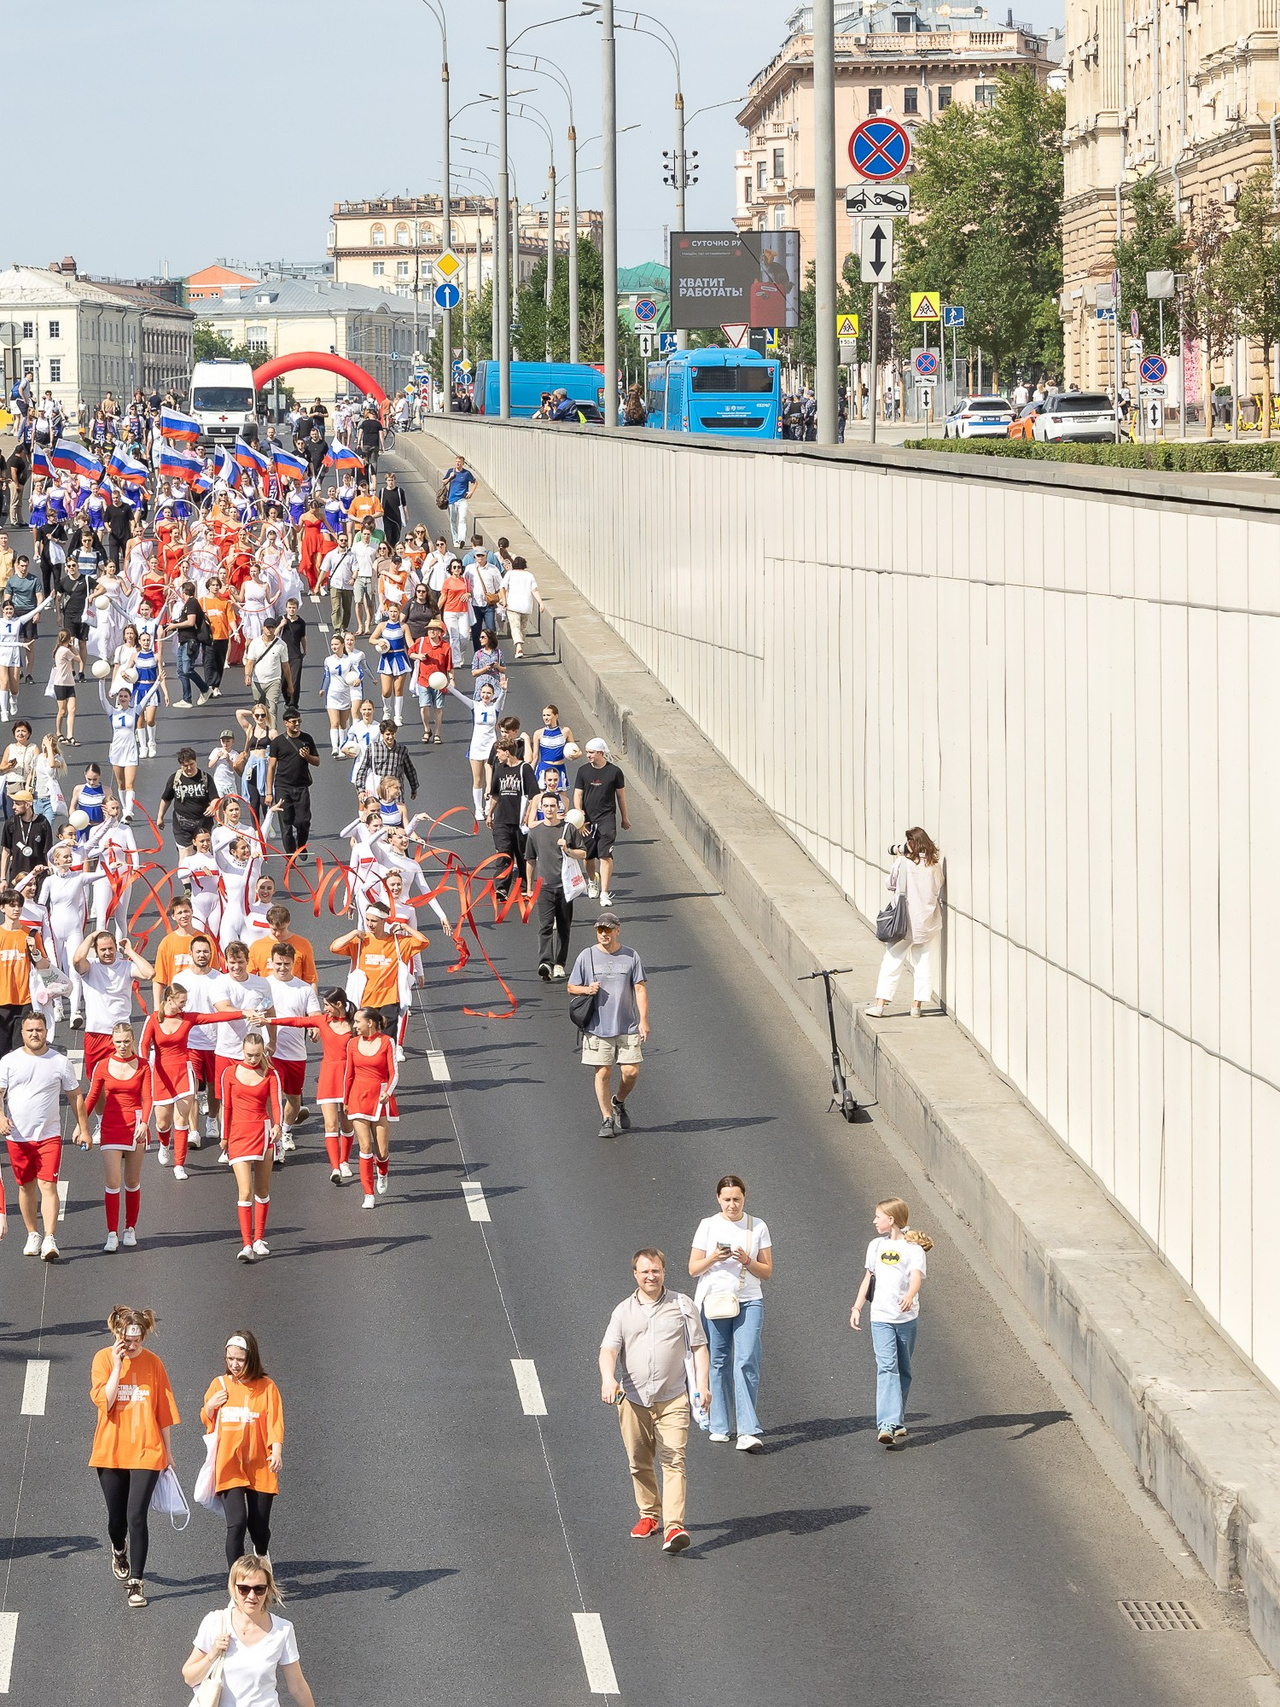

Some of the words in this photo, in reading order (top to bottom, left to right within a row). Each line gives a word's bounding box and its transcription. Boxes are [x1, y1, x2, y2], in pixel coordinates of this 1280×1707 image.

[679, 277, 726, 288] ХВАТИТ
[679, 287, 743, 297] РАБОТАТЬ!
[6, 623, 12, 633] 1
[335, 664, 342, 676] 1
[118, 715, 125, 726] 1
[481, 711, 488, 723] 1
[362, 732, 370, 745] 1
